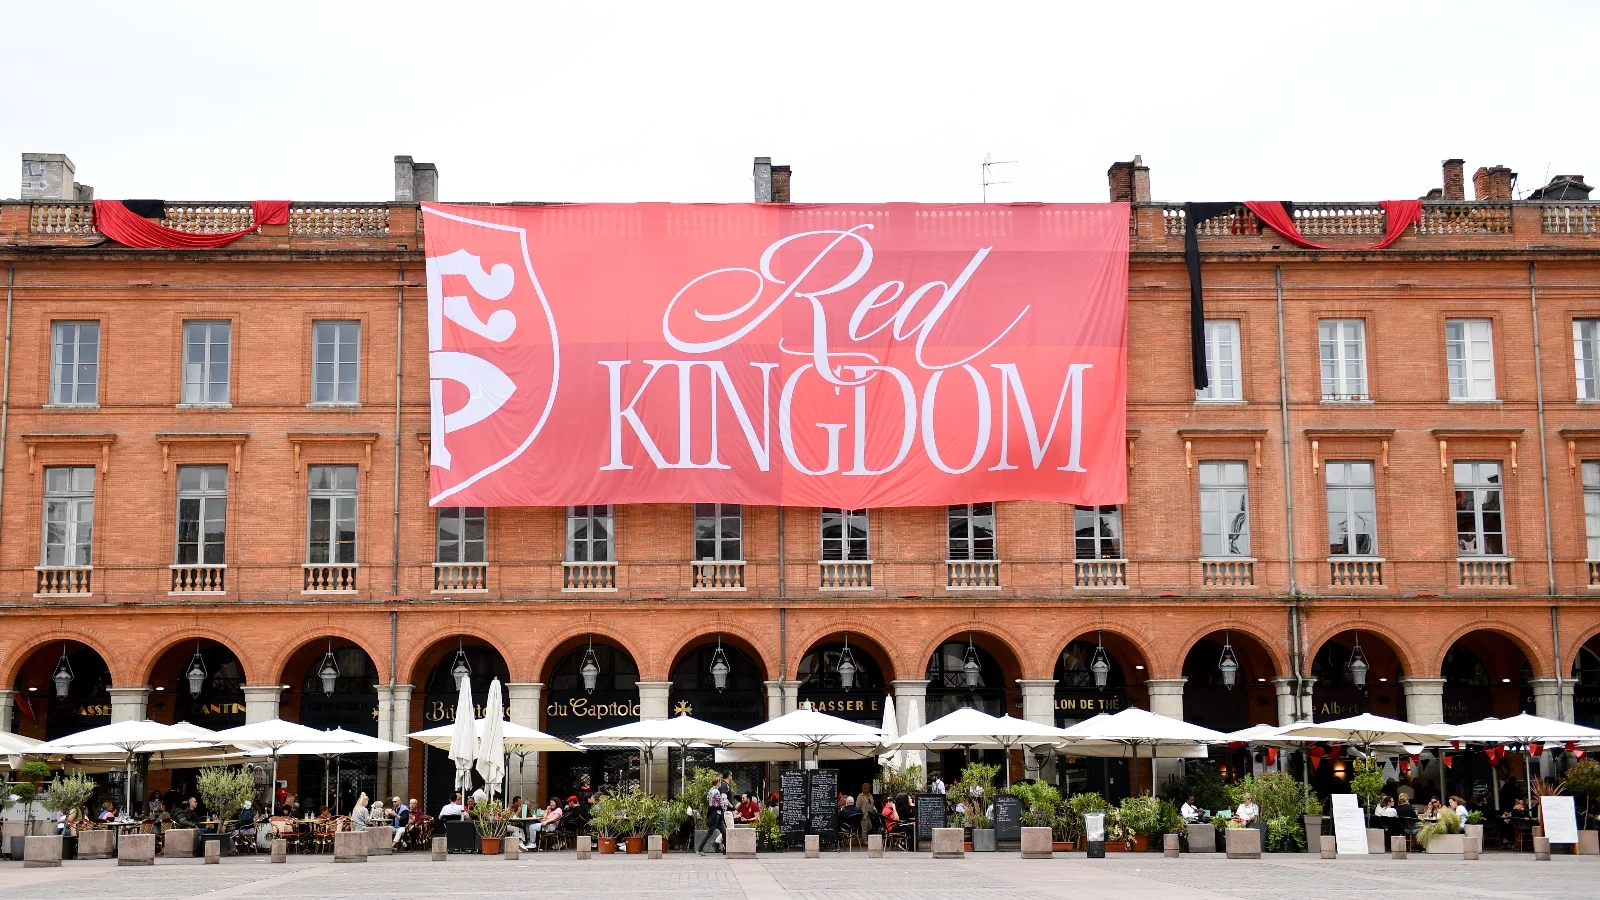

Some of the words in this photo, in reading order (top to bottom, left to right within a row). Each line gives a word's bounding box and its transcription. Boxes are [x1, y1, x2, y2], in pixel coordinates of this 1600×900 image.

[662, 223, 1031, 387] Red
[597, 358, 1094, 477] KINGDOM
[546, 701, 568, 717] du
[569, 698, 641, 720] Capitole
[1054, 699, 1076, 710] LON
[1080, 699, 1094, 710] DE
[1097, 695, 1119, 710] THÉ
[1320, 701, 1359, 715] Albert
